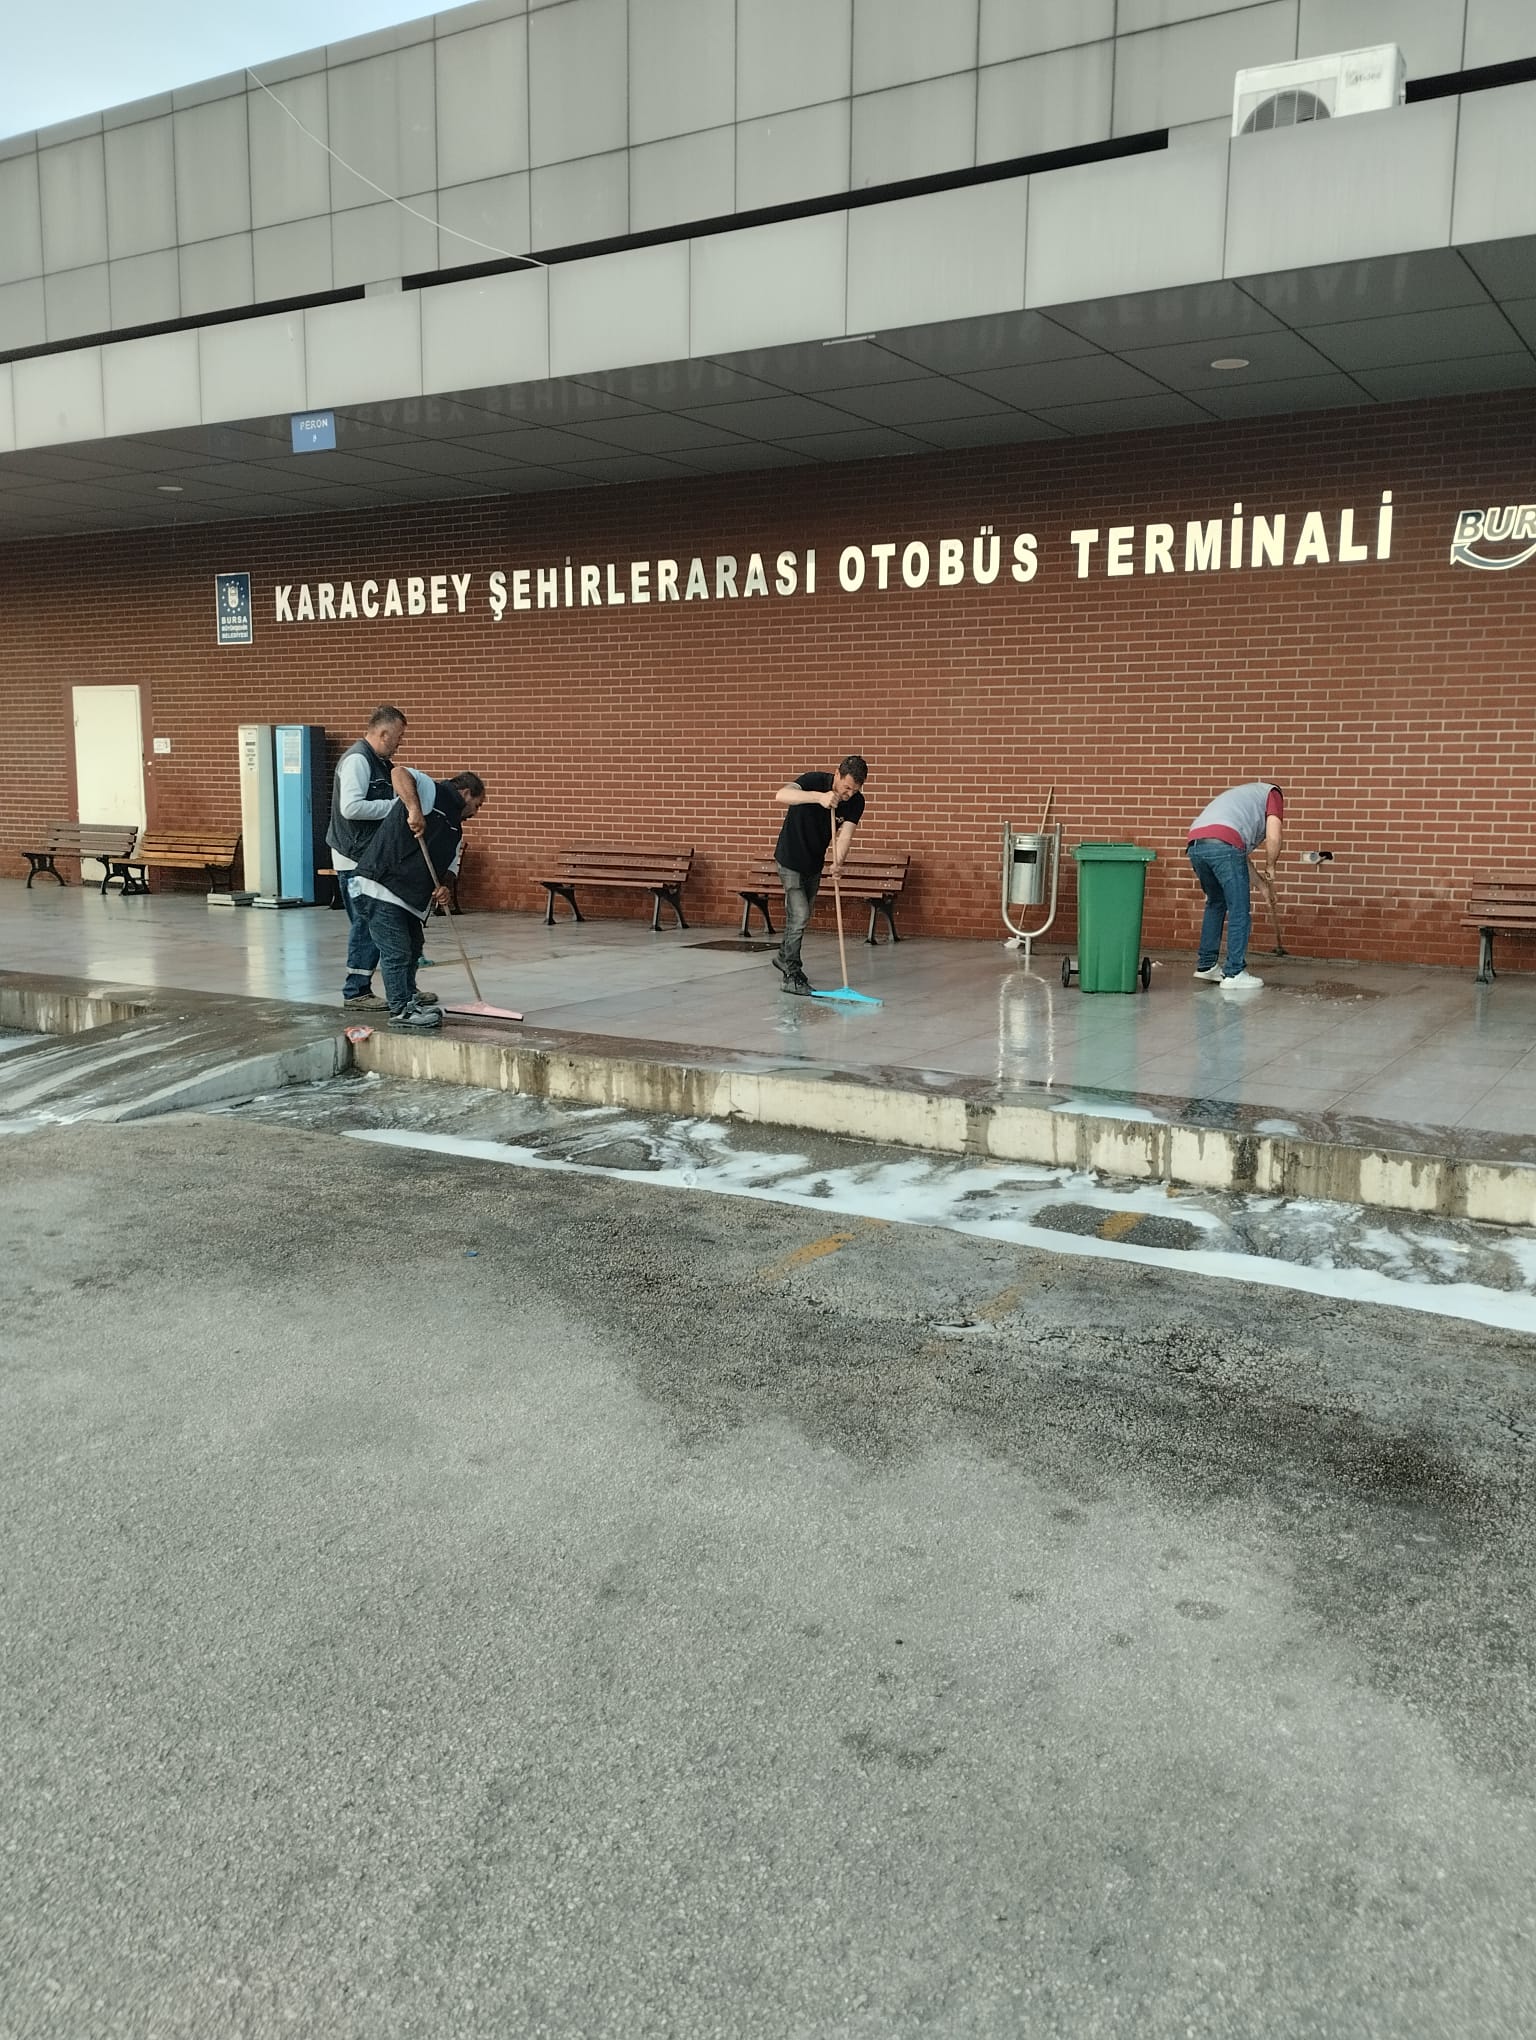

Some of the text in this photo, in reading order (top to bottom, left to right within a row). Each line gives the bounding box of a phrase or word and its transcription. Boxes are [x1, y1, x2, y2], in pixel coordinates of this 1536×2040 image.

[299, 418, 328, 431] PERON
[275, 490, 1393, 622] KARACABEY ŞEHİRLERARASI OTOBÜS TERMİNALİ
[221, 616, 248, 625] BURSA
